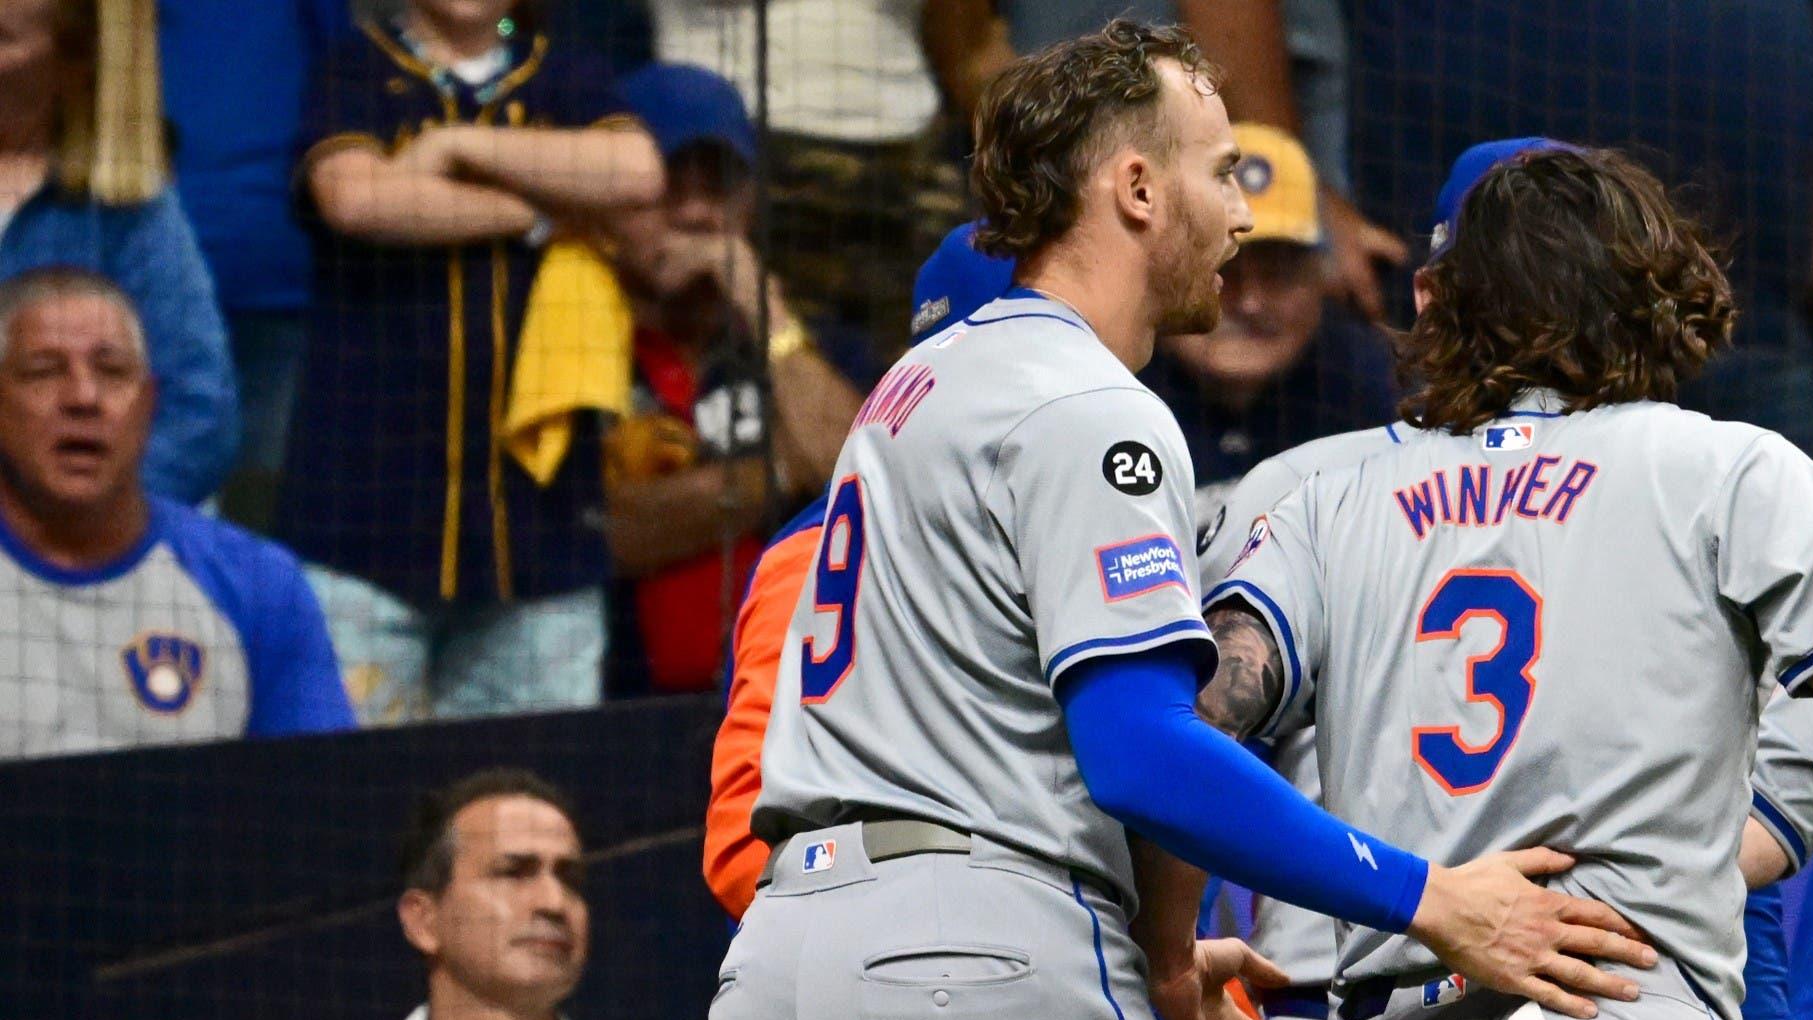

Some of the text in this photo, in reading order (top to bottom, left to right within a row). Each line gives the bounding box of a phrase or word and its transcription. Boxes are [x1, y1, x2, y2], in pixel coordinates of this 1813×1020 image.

[1112, 452, 1156, 485] 24
[1393, 453, 1598, 541] WINKER
[800, 473, 866, 706] 9
[1411, 568, 1544, 797] 3
